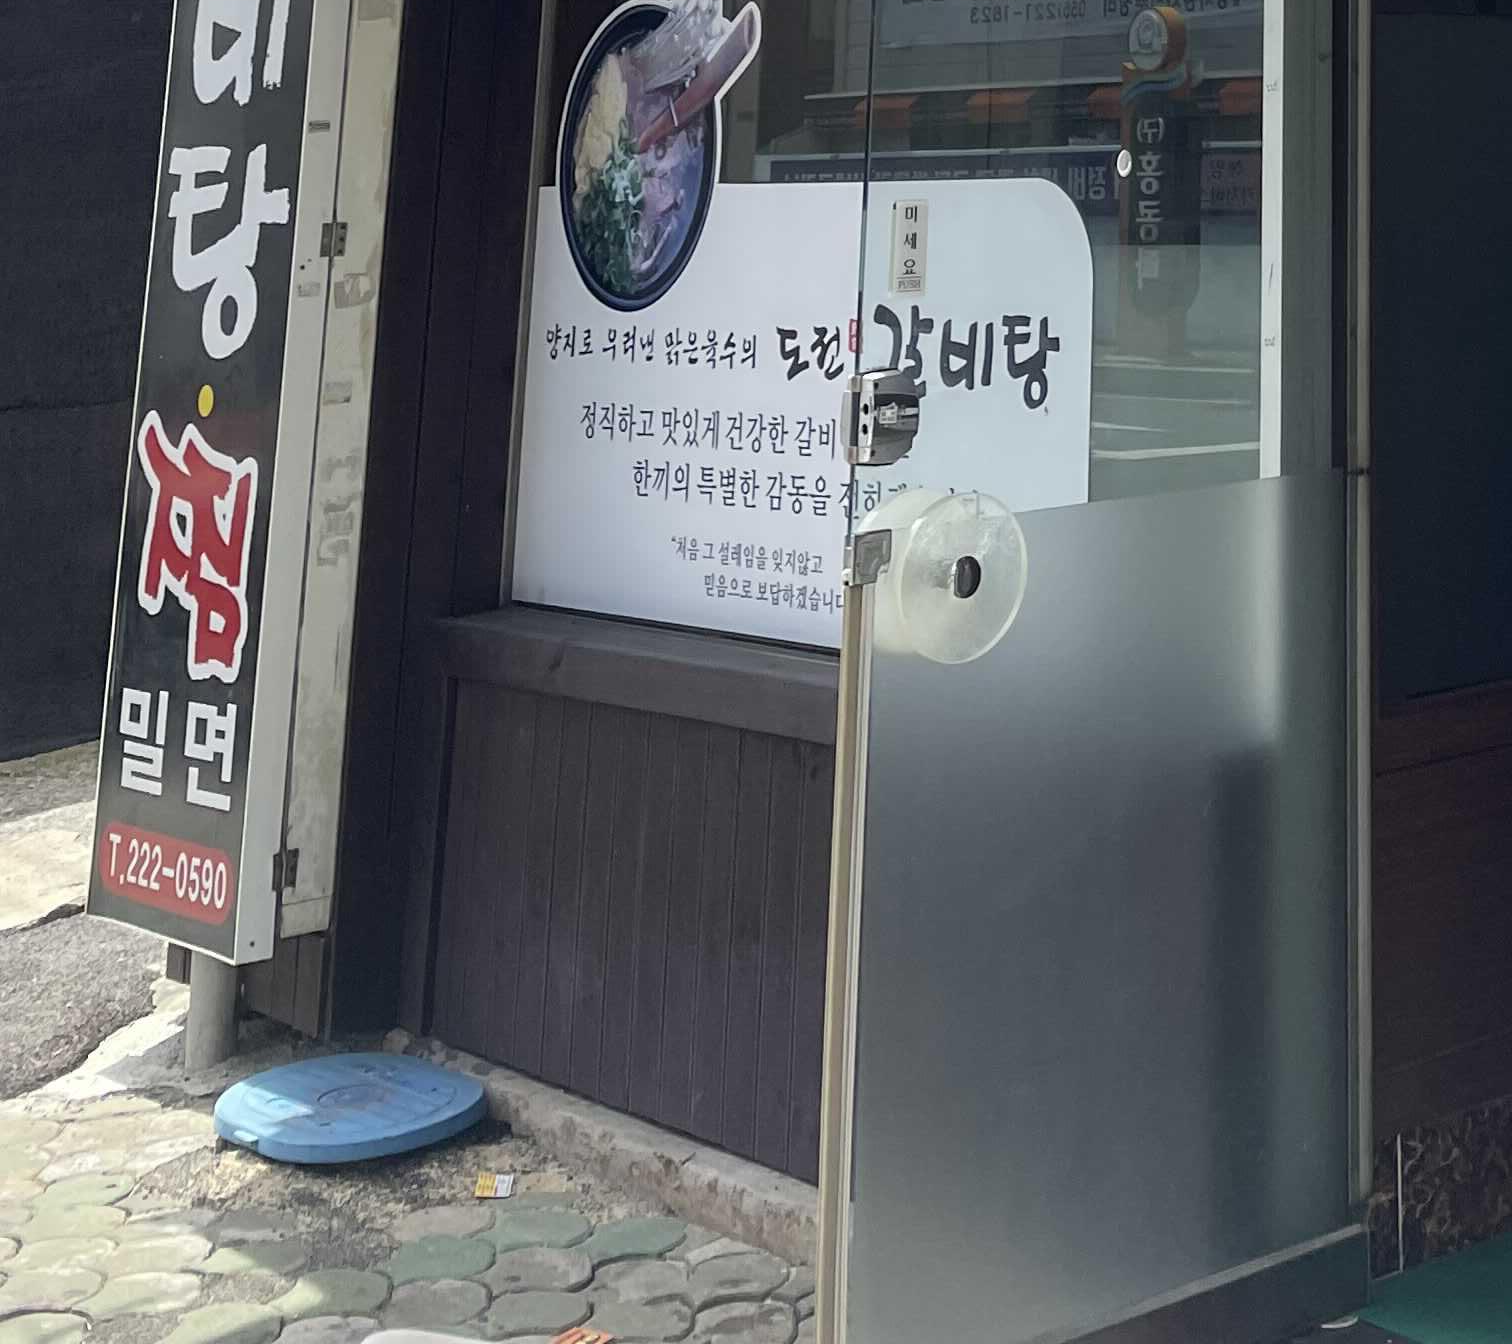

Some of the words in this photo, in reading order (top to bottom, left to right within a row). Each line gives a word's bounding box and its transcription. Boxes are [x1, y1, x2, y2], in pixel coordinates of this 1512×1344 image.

[901, 205, 919, 277] 미세요
[546, 324, 593, 360] 양지로
[602, 325, 655, 363] 우려낸
[776, 325, 845, 380] 도전
[873, 303, 1061, 409] 갈비탕
[580, 402, 655, 443] 정직하고
[662, 407, 720, 450] 맛있게
[726, 414, 788, 454] 건강한
[633, 459, 690, 503] 한끼의
[697, 467, 760, 508] 특별한
[766, 472, 832, 516] 감동을
[703, 544, 716, 560] 그
[120, 687, 237, 812] 밀면
[108, 833, 227, 909] T.222-0590
